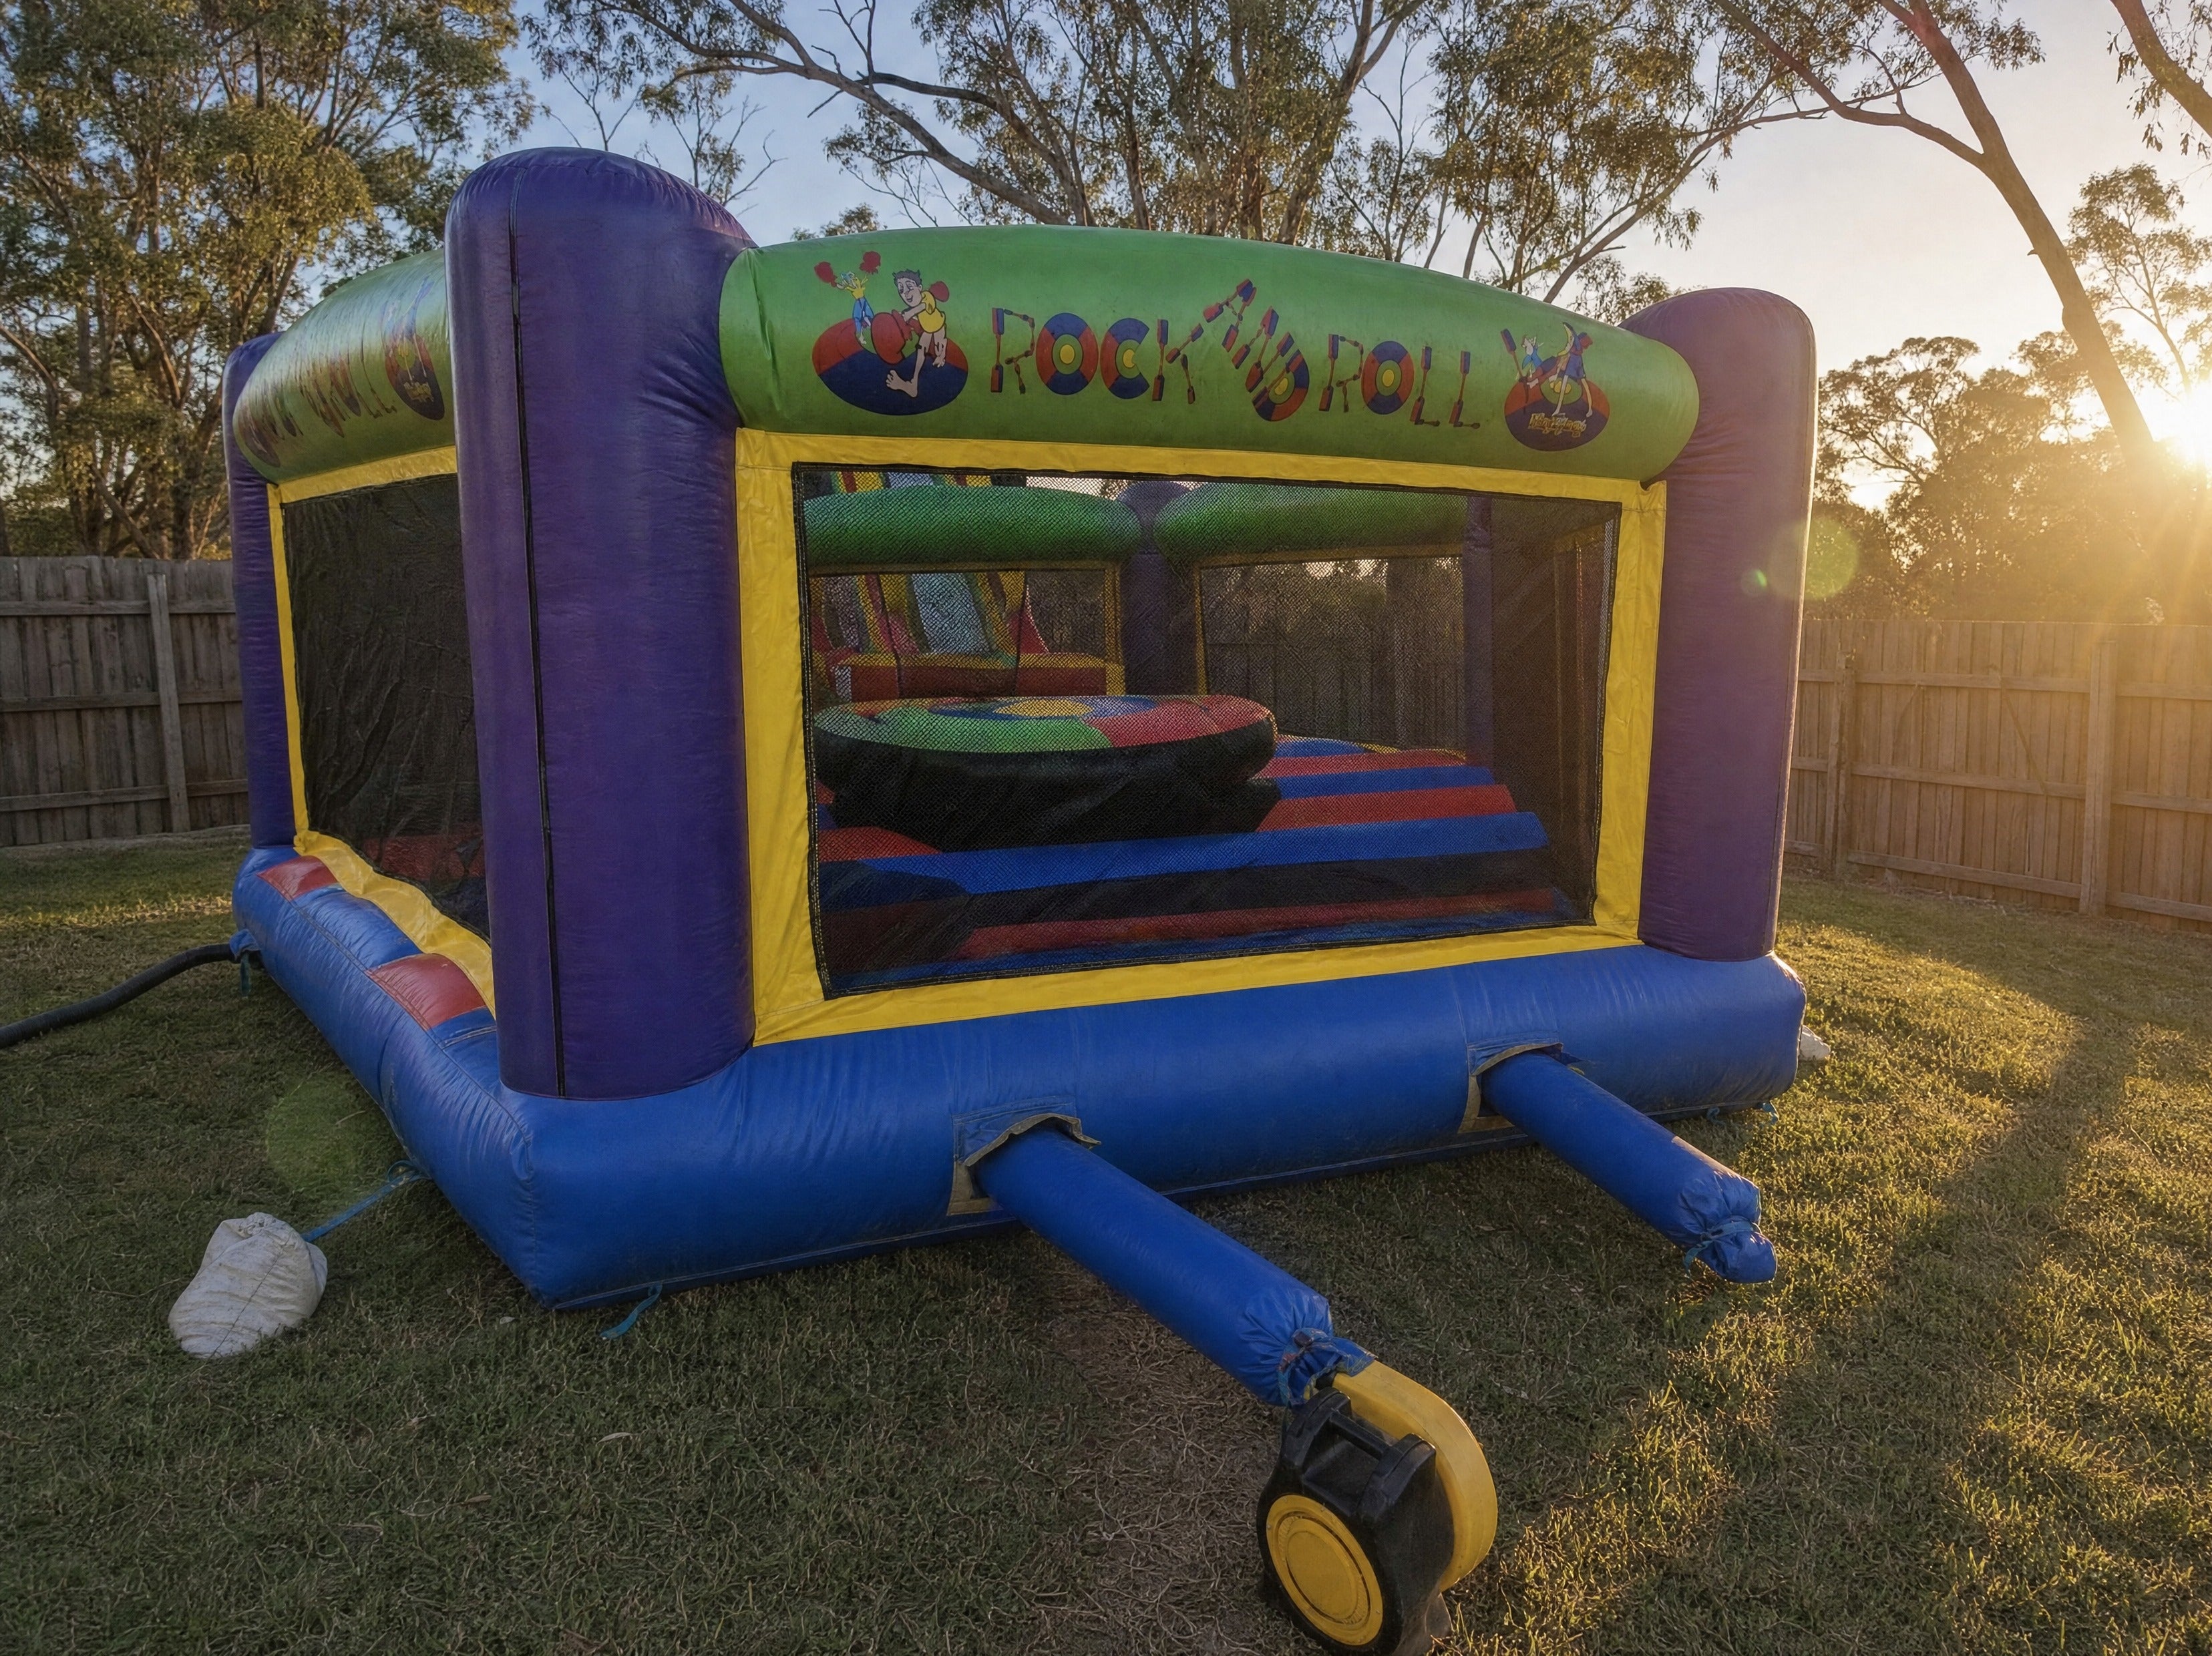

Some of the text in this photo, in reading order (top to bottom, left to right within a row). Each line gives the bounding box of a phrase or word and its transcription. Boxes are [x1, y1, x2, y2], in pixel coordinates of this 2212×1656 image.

[990, 278, 1481, 427] ROCK AND ROLL
